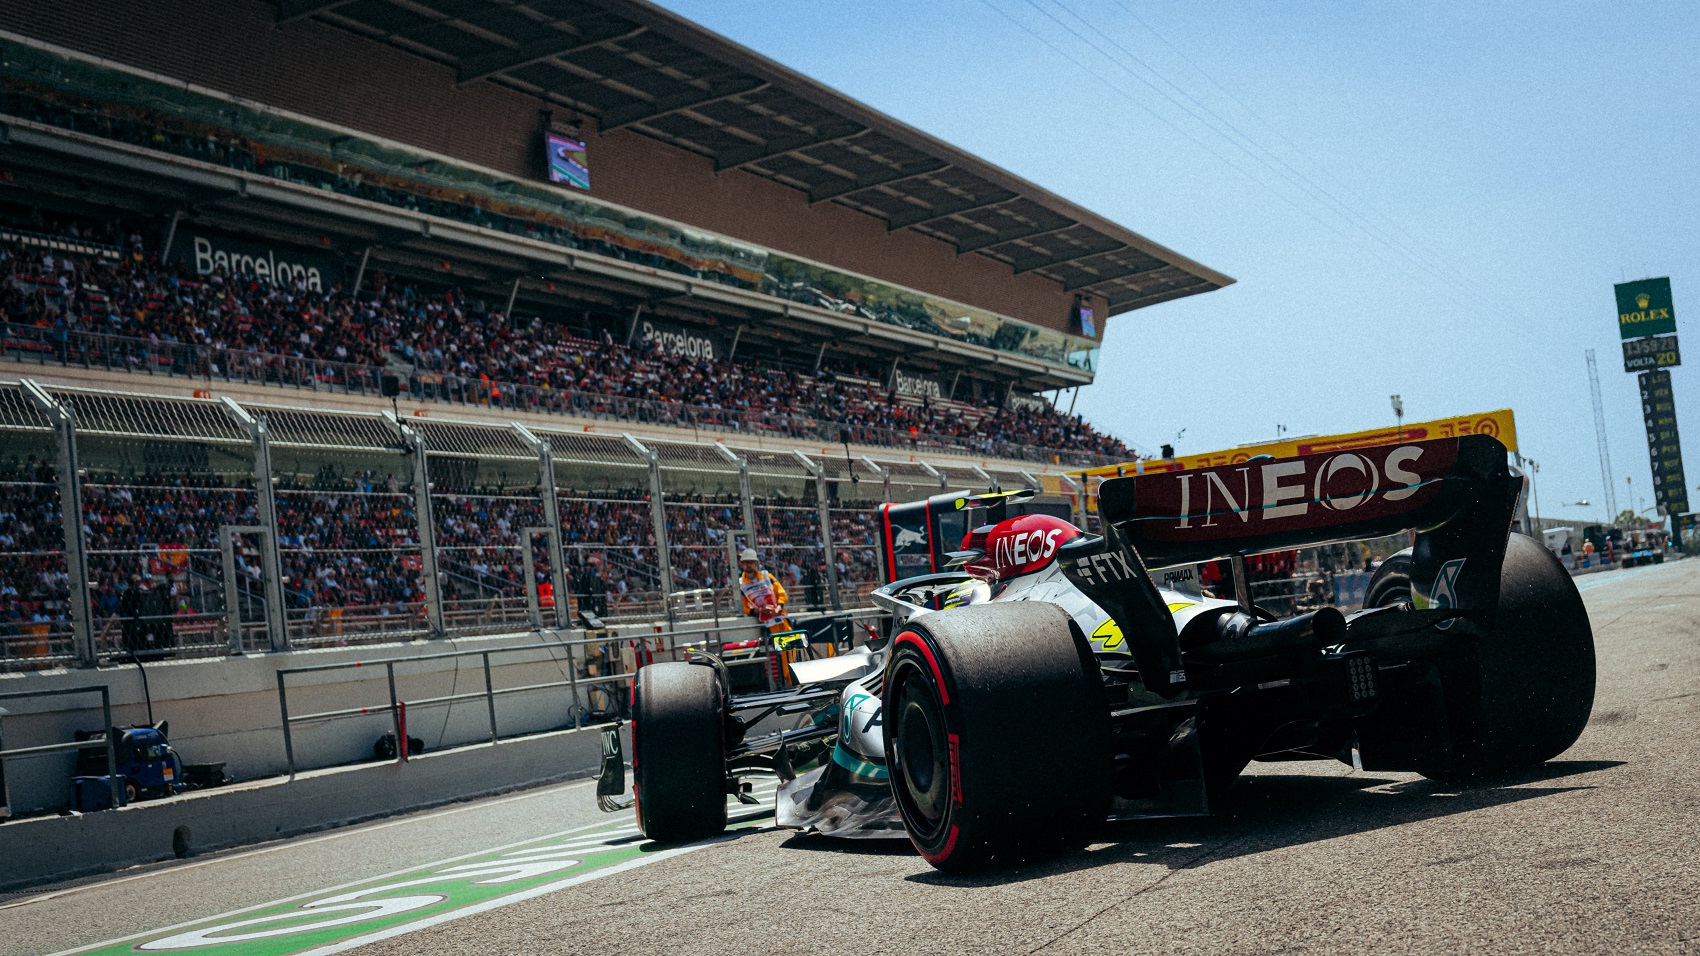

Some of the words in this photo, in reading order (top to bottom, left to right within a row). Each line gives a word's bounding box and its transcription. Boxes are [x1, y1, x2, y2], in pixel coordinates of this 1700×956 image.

[194, 236, 323, 294] Barcelona
[1620, 308, 1669, 324] ROLEX
[1657, 351, 1677, 365] 20
[895, 369, 941, 399] Barcelona
[1641, 390, 1649, 399] 2
[1643, 404, 1651, 414] 3
[1651, 447, 1658, 456] 6
[1653, 461, 1659, 471] 7
[1175, 446, 1424, 529] INEOS
[995, 528, 1063, 569] INEOS
[1091, 550, 1137, 583] FTX
[601, 730, 618, 756] IWC
